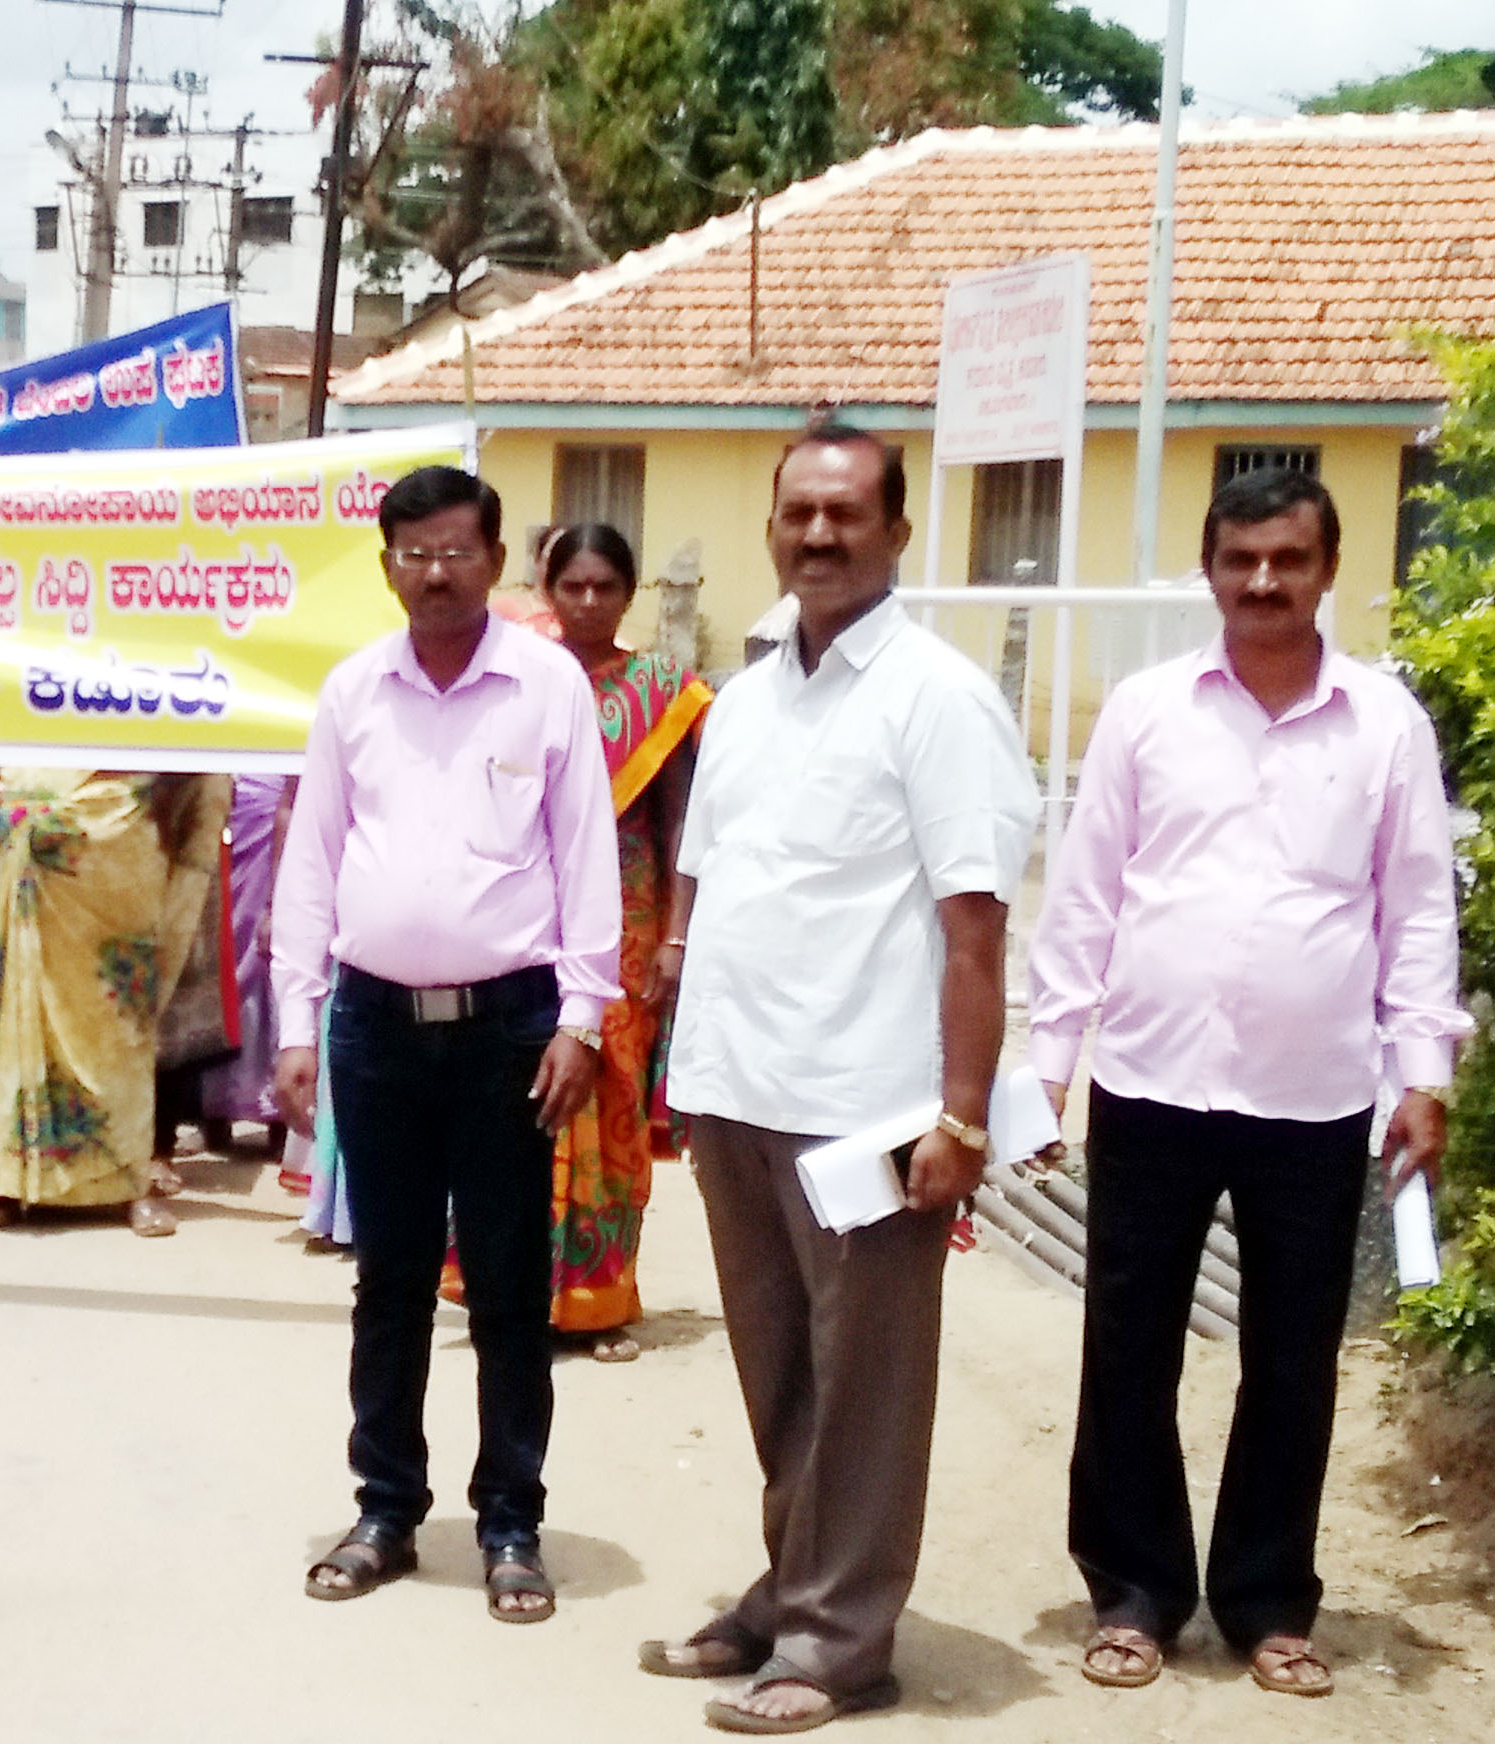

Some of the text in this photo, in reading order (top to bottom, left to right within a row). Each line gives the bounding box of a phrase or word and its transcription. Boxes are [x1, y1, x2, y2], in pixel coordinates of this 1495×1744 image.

[102, 348, 155, 406] ಉಪ
[194, 474, 321, 530] ಅಭಿಯಾನ
[110, 551, 292, 631] ಕಾರ್ಯಕ್ರಮ
[28, 652, 229, 715] ಕಡೂರು
